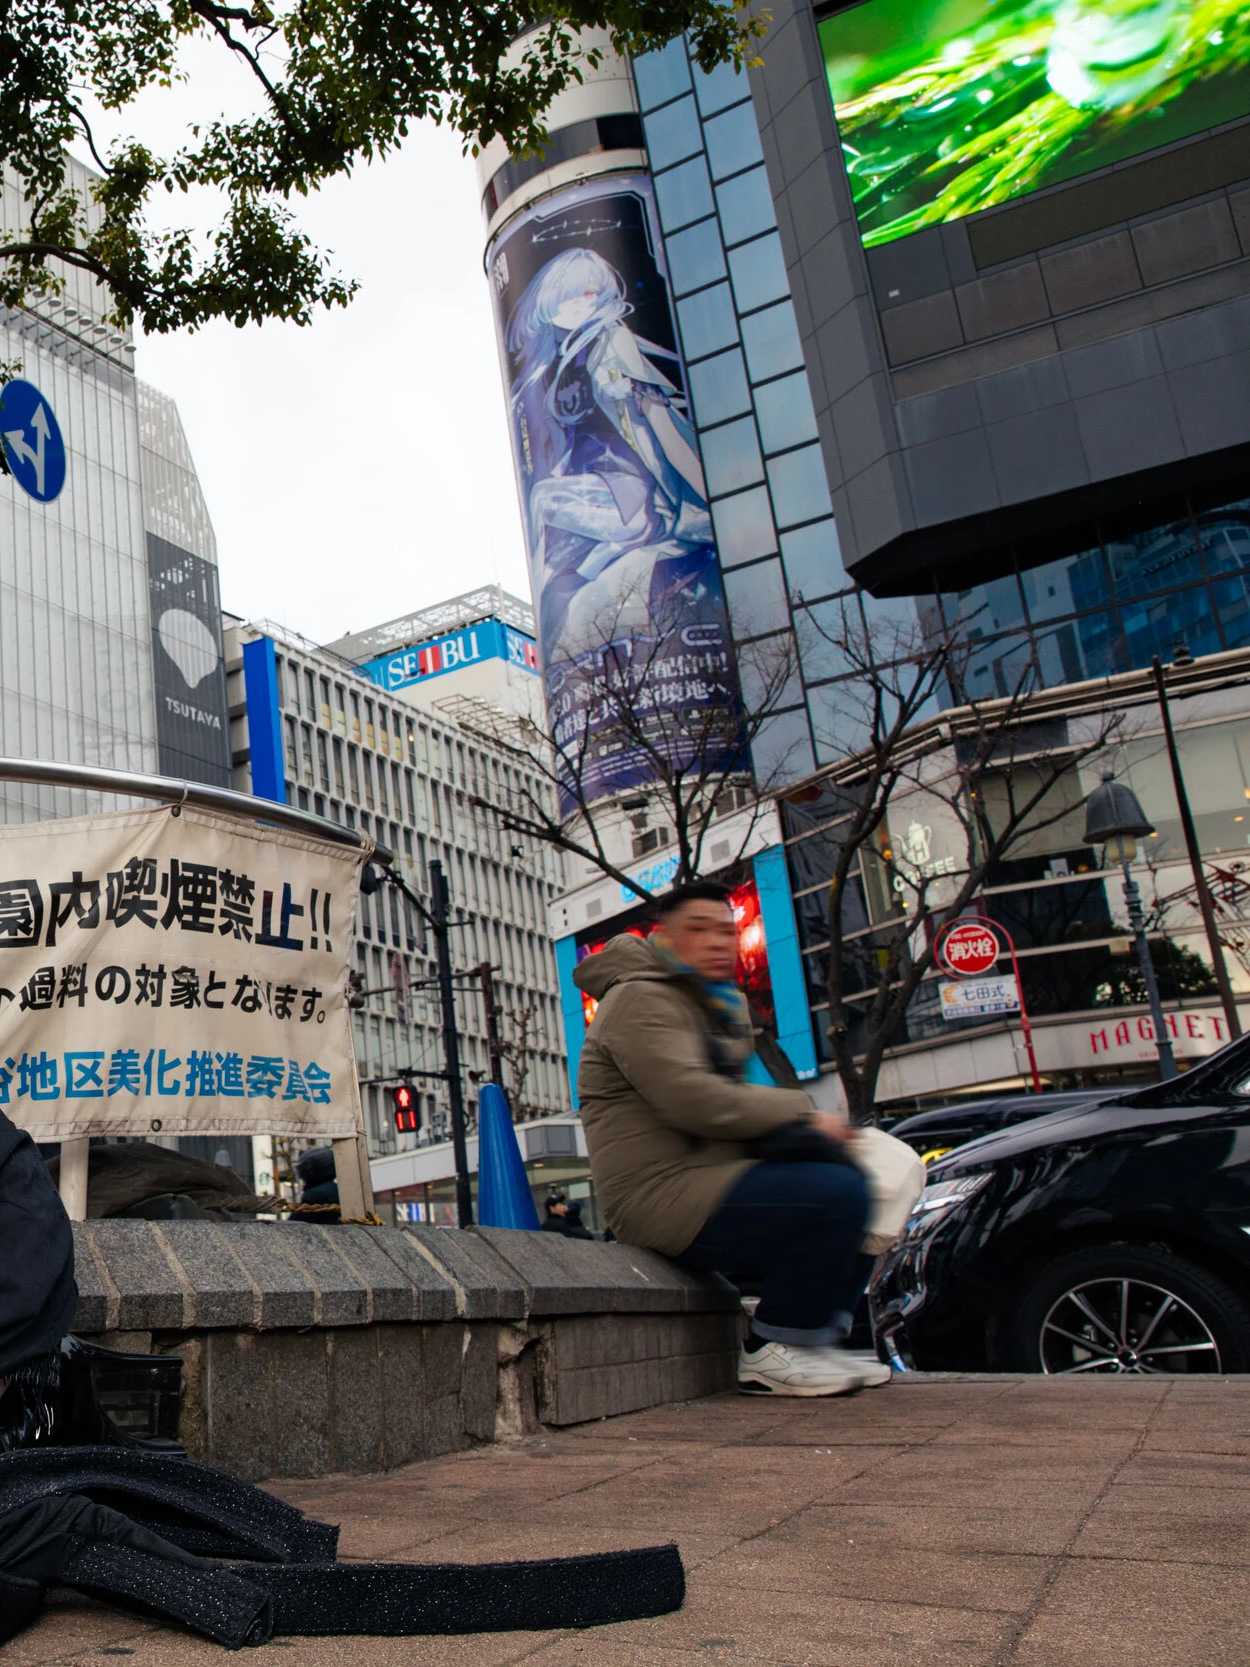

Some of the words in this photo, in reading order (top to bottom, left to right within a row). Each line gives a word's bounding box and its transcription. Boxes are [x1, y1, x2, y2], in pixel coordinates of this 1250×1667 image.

[388, 632, 480, 686] SEIBU
[165, 697, 221, 730] TSUTAYA
[949, 937, 993, 961] 消火栓
[963, 985, 1005, 1001] 七田式
[1090, 1014, 1224, 1054] MAGNET
